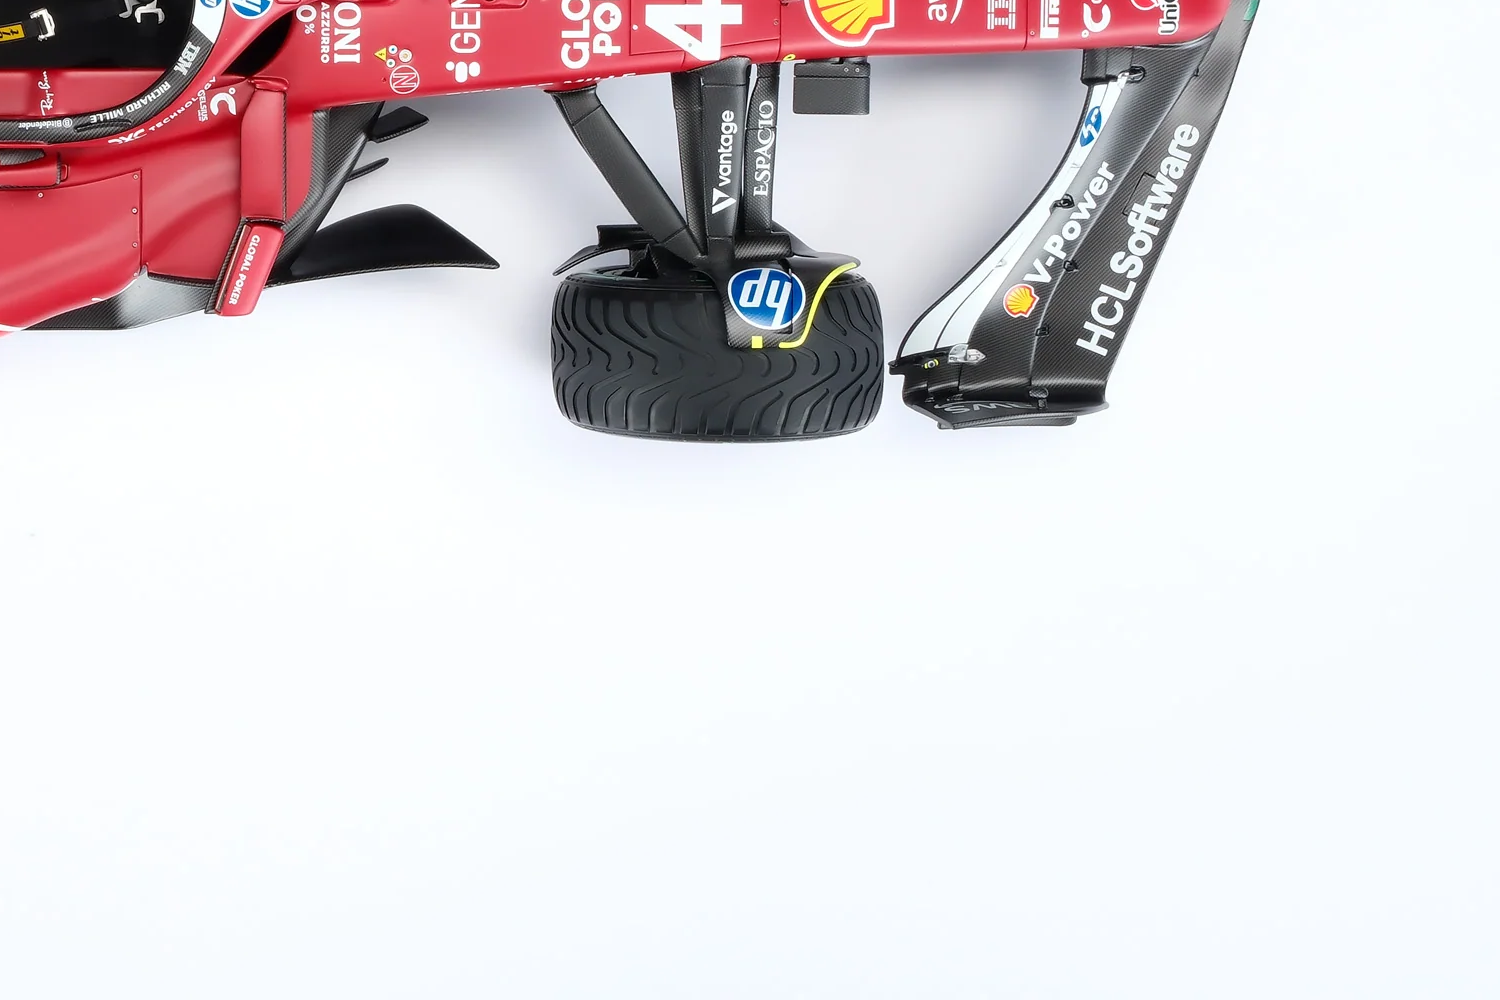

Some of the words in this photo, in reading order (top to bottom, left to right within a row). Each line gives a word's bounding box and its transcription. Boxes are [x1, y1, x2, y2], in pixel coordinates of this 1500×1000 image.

[174, 41, 200, 75] IBM
[320, 2, 331, 64] AZZURRO
[38, 71, 54, 116] Ray-Ban
[90, 109, 124, 124] MILLE
[126, 81, 171, 113] RICHARD
[149, 76, 216, 131] TECHNOLOGY
[18, 120, 62, 130] Bitdefender
[717, 110, 735, 187] vantage
[753, 100, 774, 197] ESPACIO
[1022, 161, 1115, 284] V-Power
[1075, 124, 1200, 356] HCLSoftware
[241, 234, 260, 272] GLOBAL
[229, 273, 247, 305] POKER
[736, 269, 797, 328] hp
